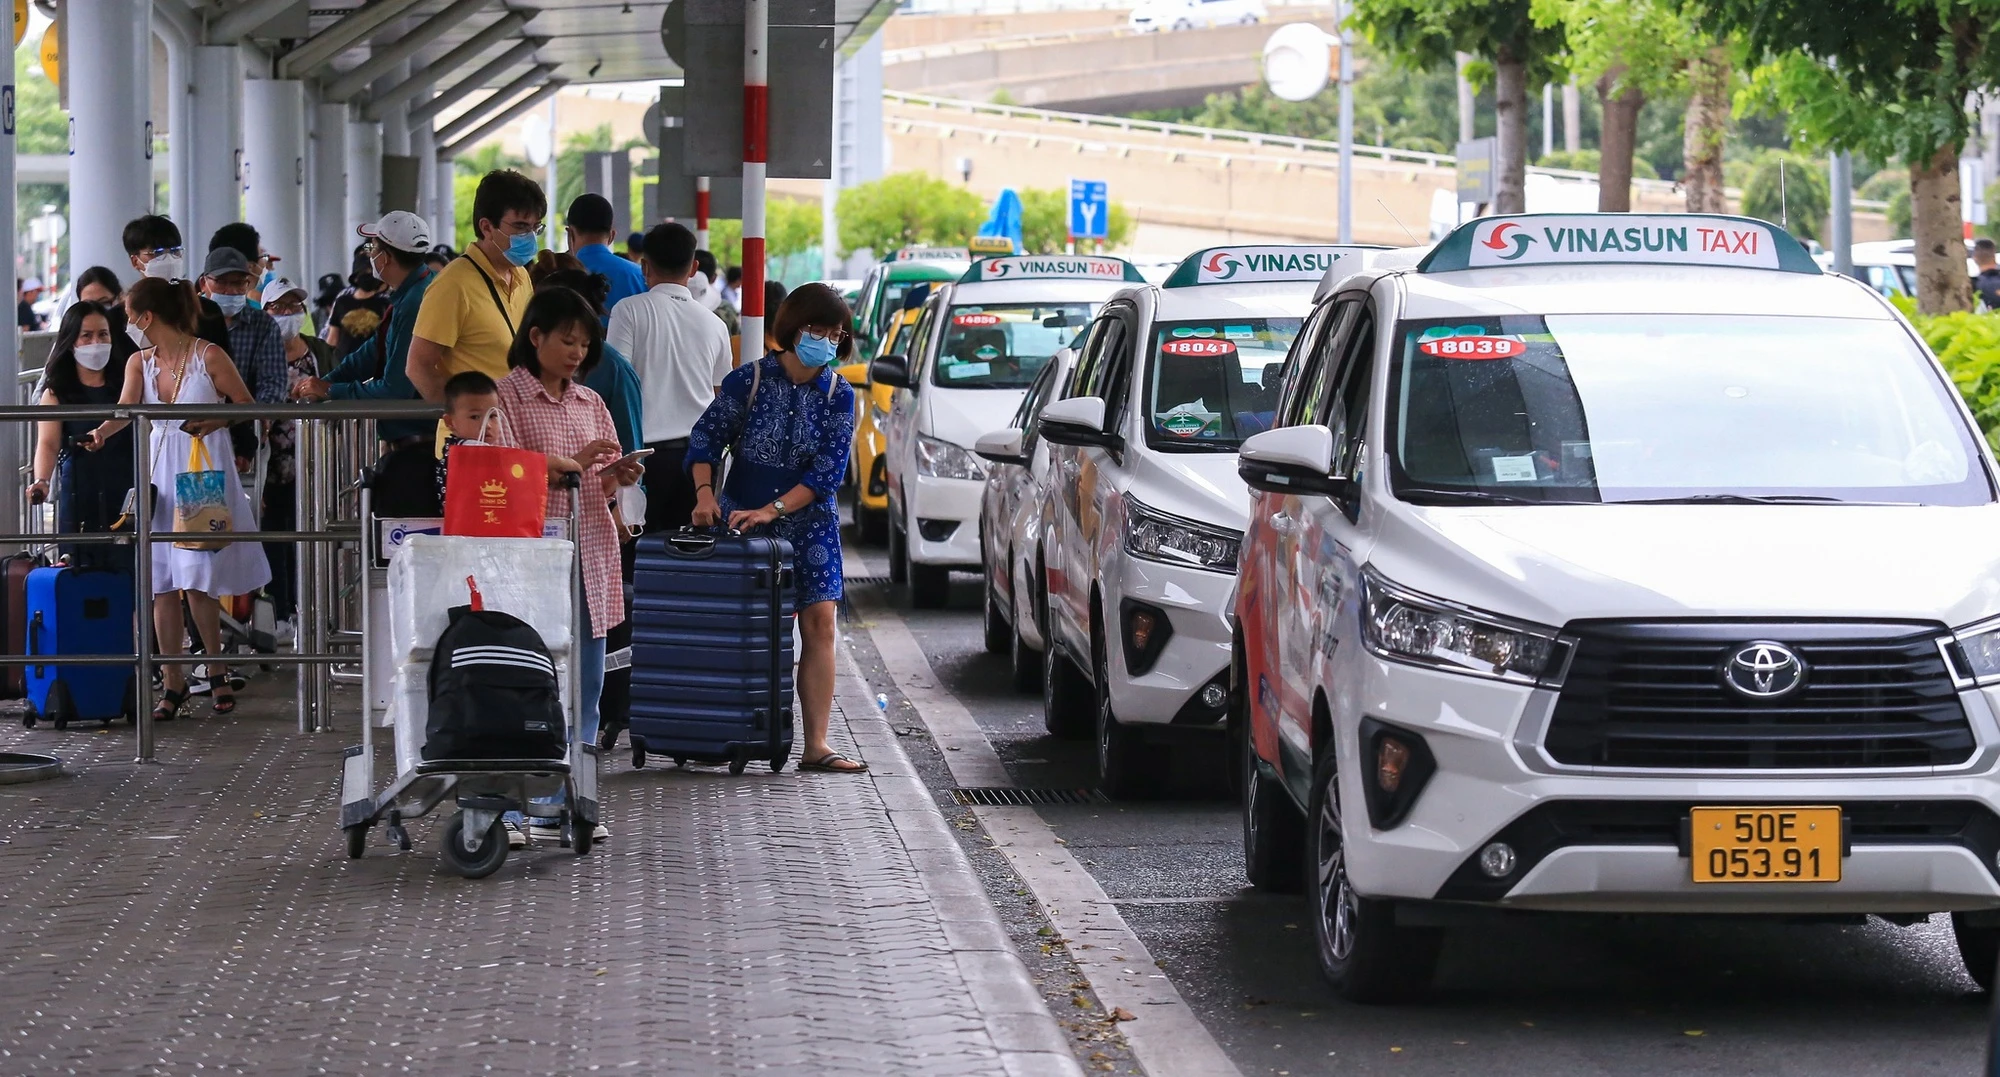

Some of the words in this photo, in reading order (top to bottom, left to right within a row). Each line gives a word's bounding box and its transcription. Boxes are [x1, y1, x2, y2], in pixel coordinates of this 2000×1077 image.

[1544, 226, 1687, 252] VINASUN
[1696, 228, 1758, 255] TAXI
[1019, 261, 1088, 274] VINASUN
[1089, 262, 1121, 276] TAXI
[1168, 342, 1229, 353] 18041
[1425, 339, 1512, 354] 18039
[1735, 812, 1798, 843] 50E
[1708, 847, 1821, 878] 053.91
